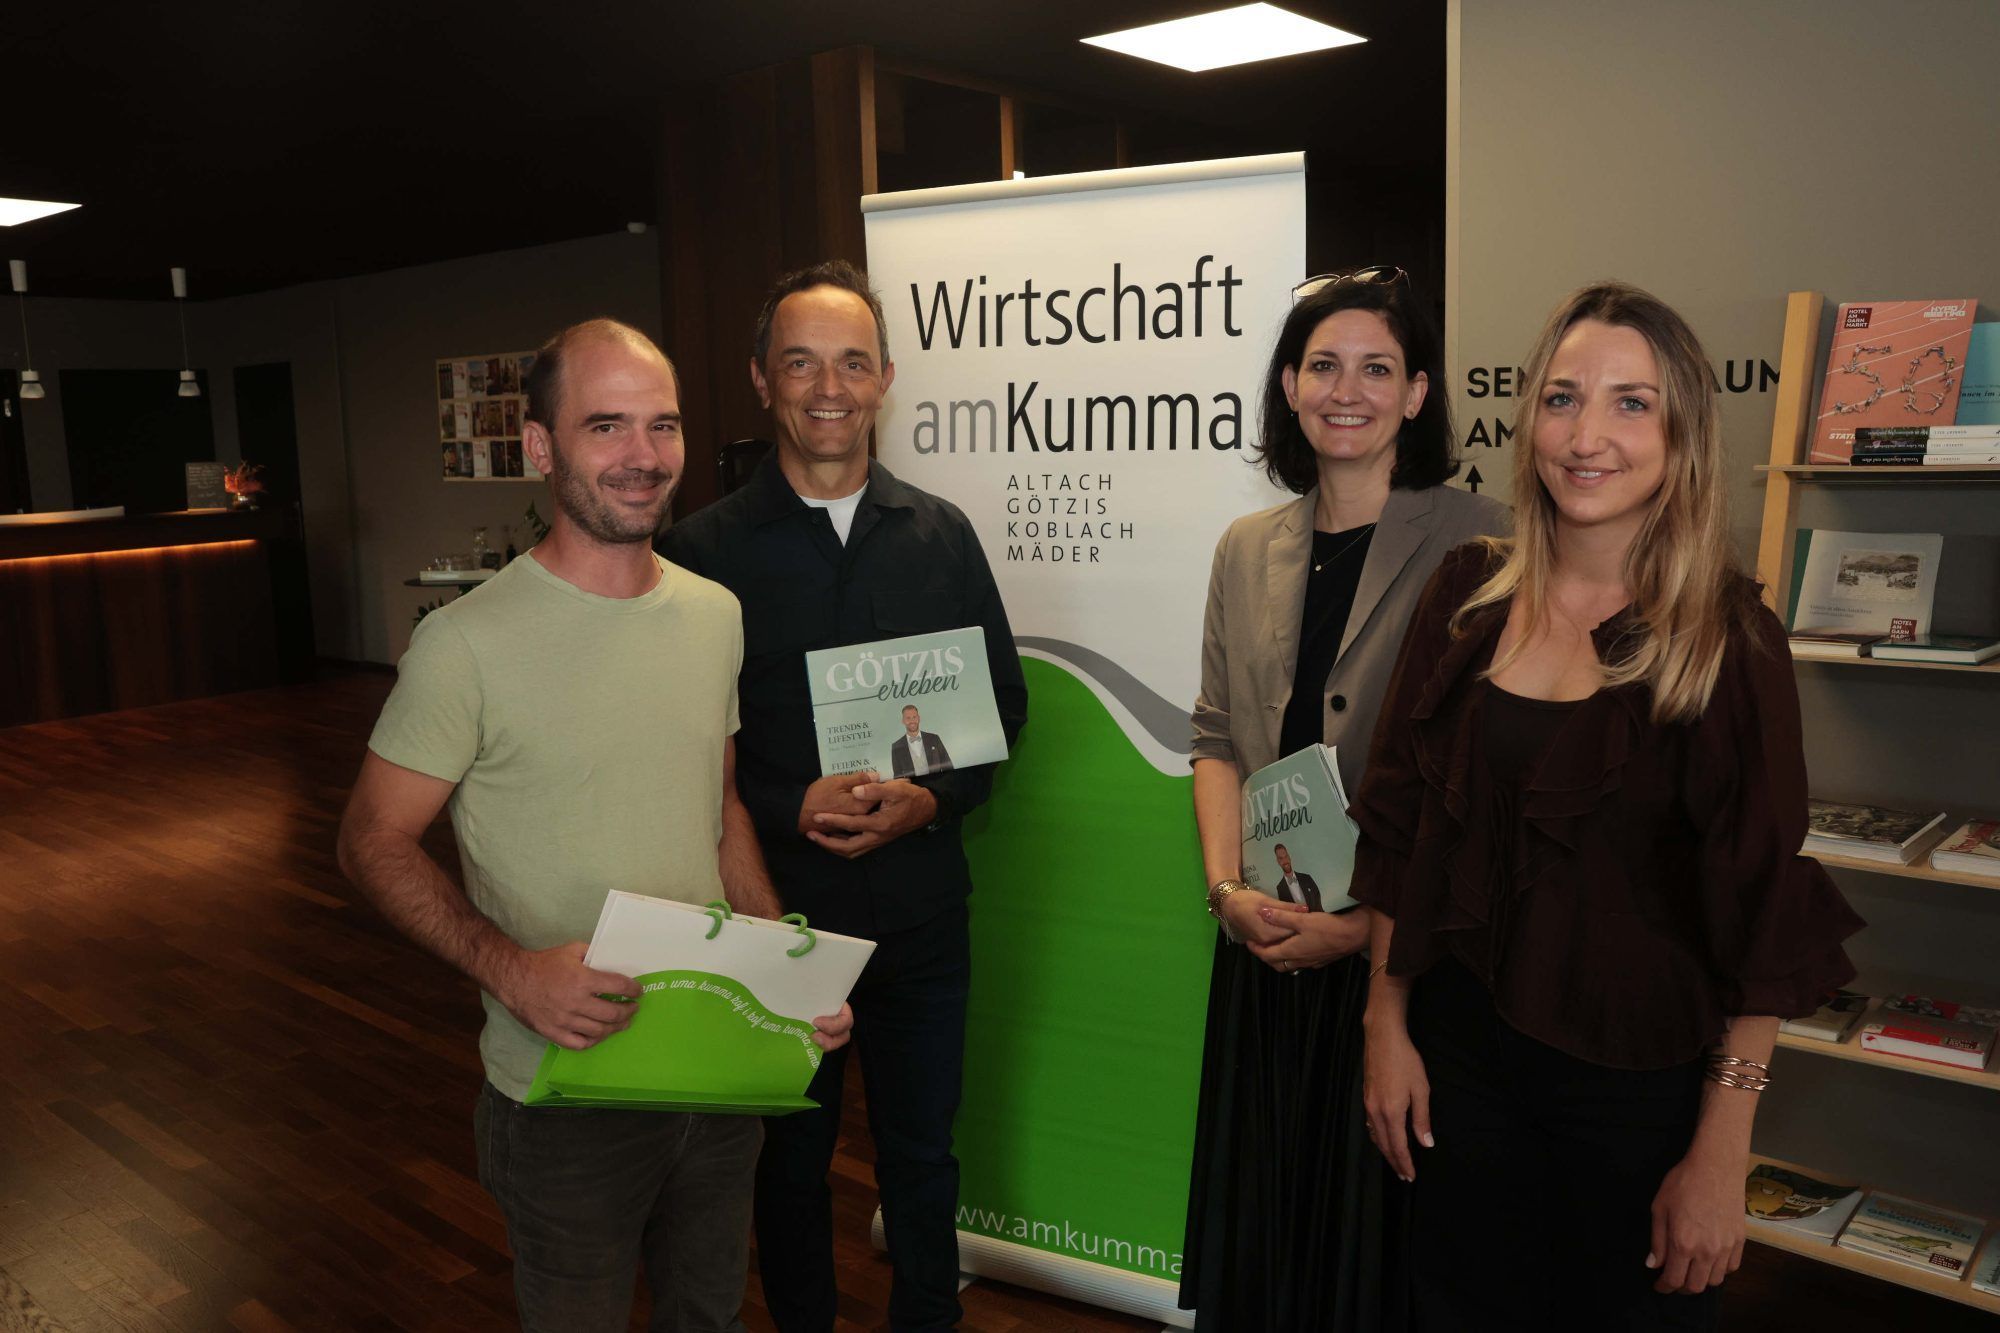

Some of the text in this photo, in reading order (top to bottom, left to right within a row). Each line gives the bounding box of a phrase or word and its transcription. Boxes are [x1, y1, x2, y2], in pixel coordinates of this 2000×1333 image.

[910, 255, 1243, 351] Wirtschaft
[912, 381, 1243, 455] amKumma
[1006, 473, 1113, 492] ALTACH
[1006, 494, 1108, 515] GÖTZIS
[1006, 521, 1134, 540] KOBLACH
[1006, 541, 1100, 563] MÄDER
[826, 646, 965, 693] GÖTZIS
[877, 670, 960, 701] erleben
[827, 721, 870, 735] TRENDS &
[828, 730, 873, 745] LIFESTYLE
[832, 760, 863, 771] FEIERN
[1255, 804, 1312, 841] erleben
[698, 980, 733, 1000] kumma
